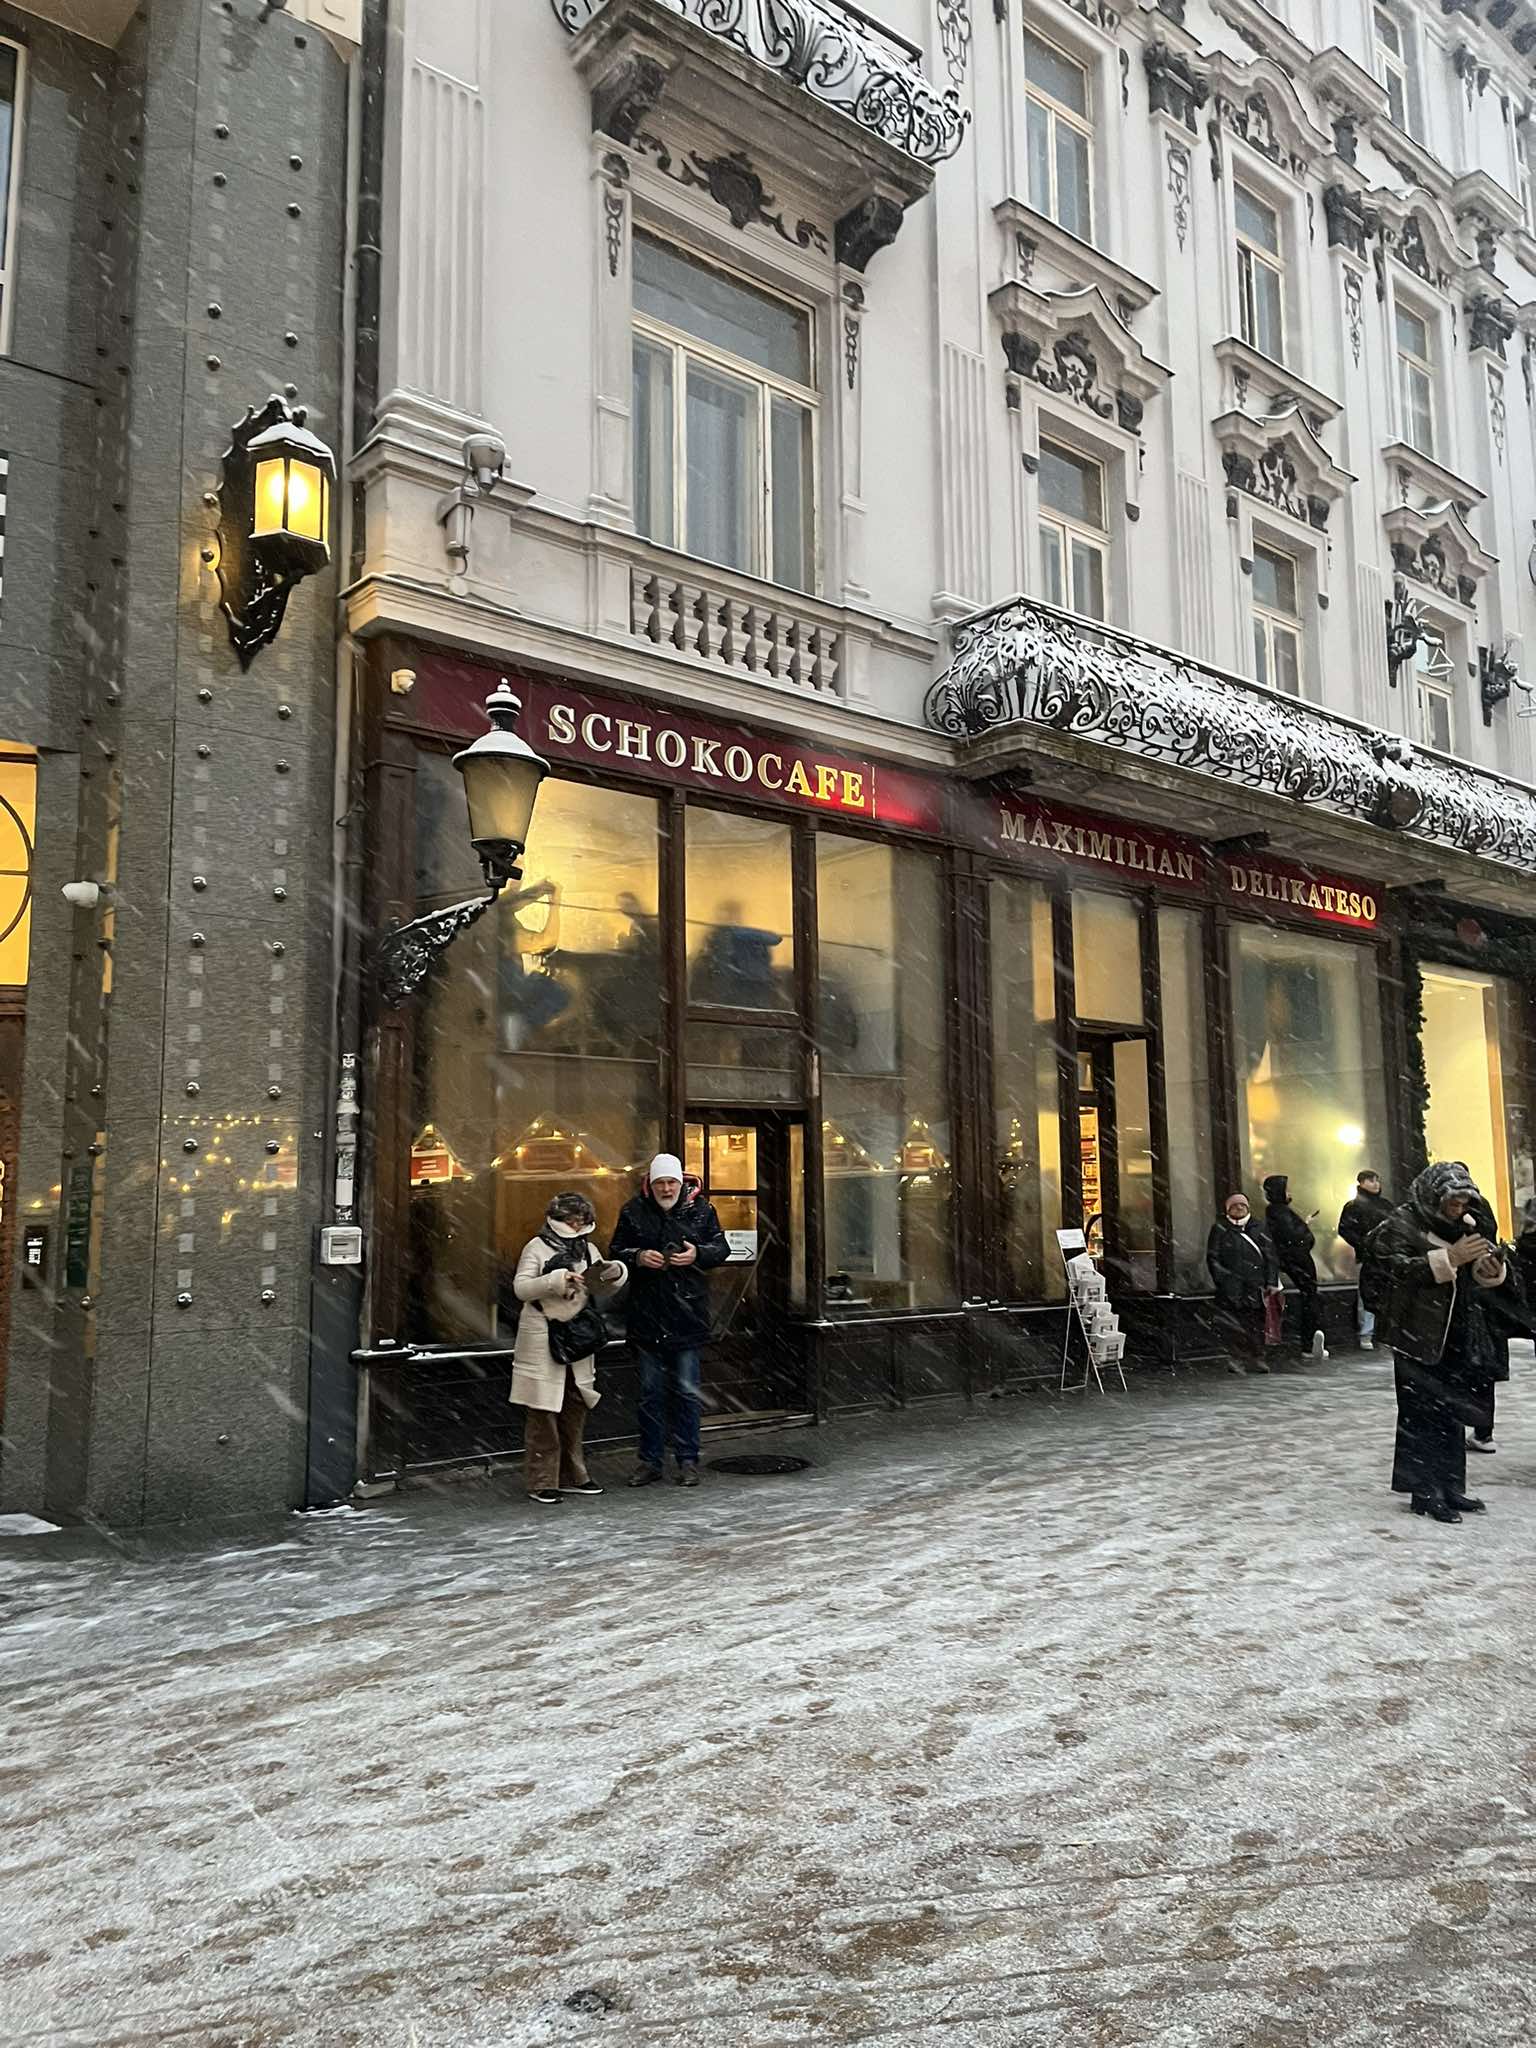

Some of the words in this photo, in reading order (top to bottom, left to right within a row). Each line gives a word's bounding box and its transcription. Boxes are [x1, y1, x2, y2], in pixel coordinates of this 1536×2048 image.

[548, 704, 865, 808] SCHOKOCAFE
[1000, 809, 1193, 880] MAXIMILIAN
[1230, 865, 1376, 921] DELIKATESO
